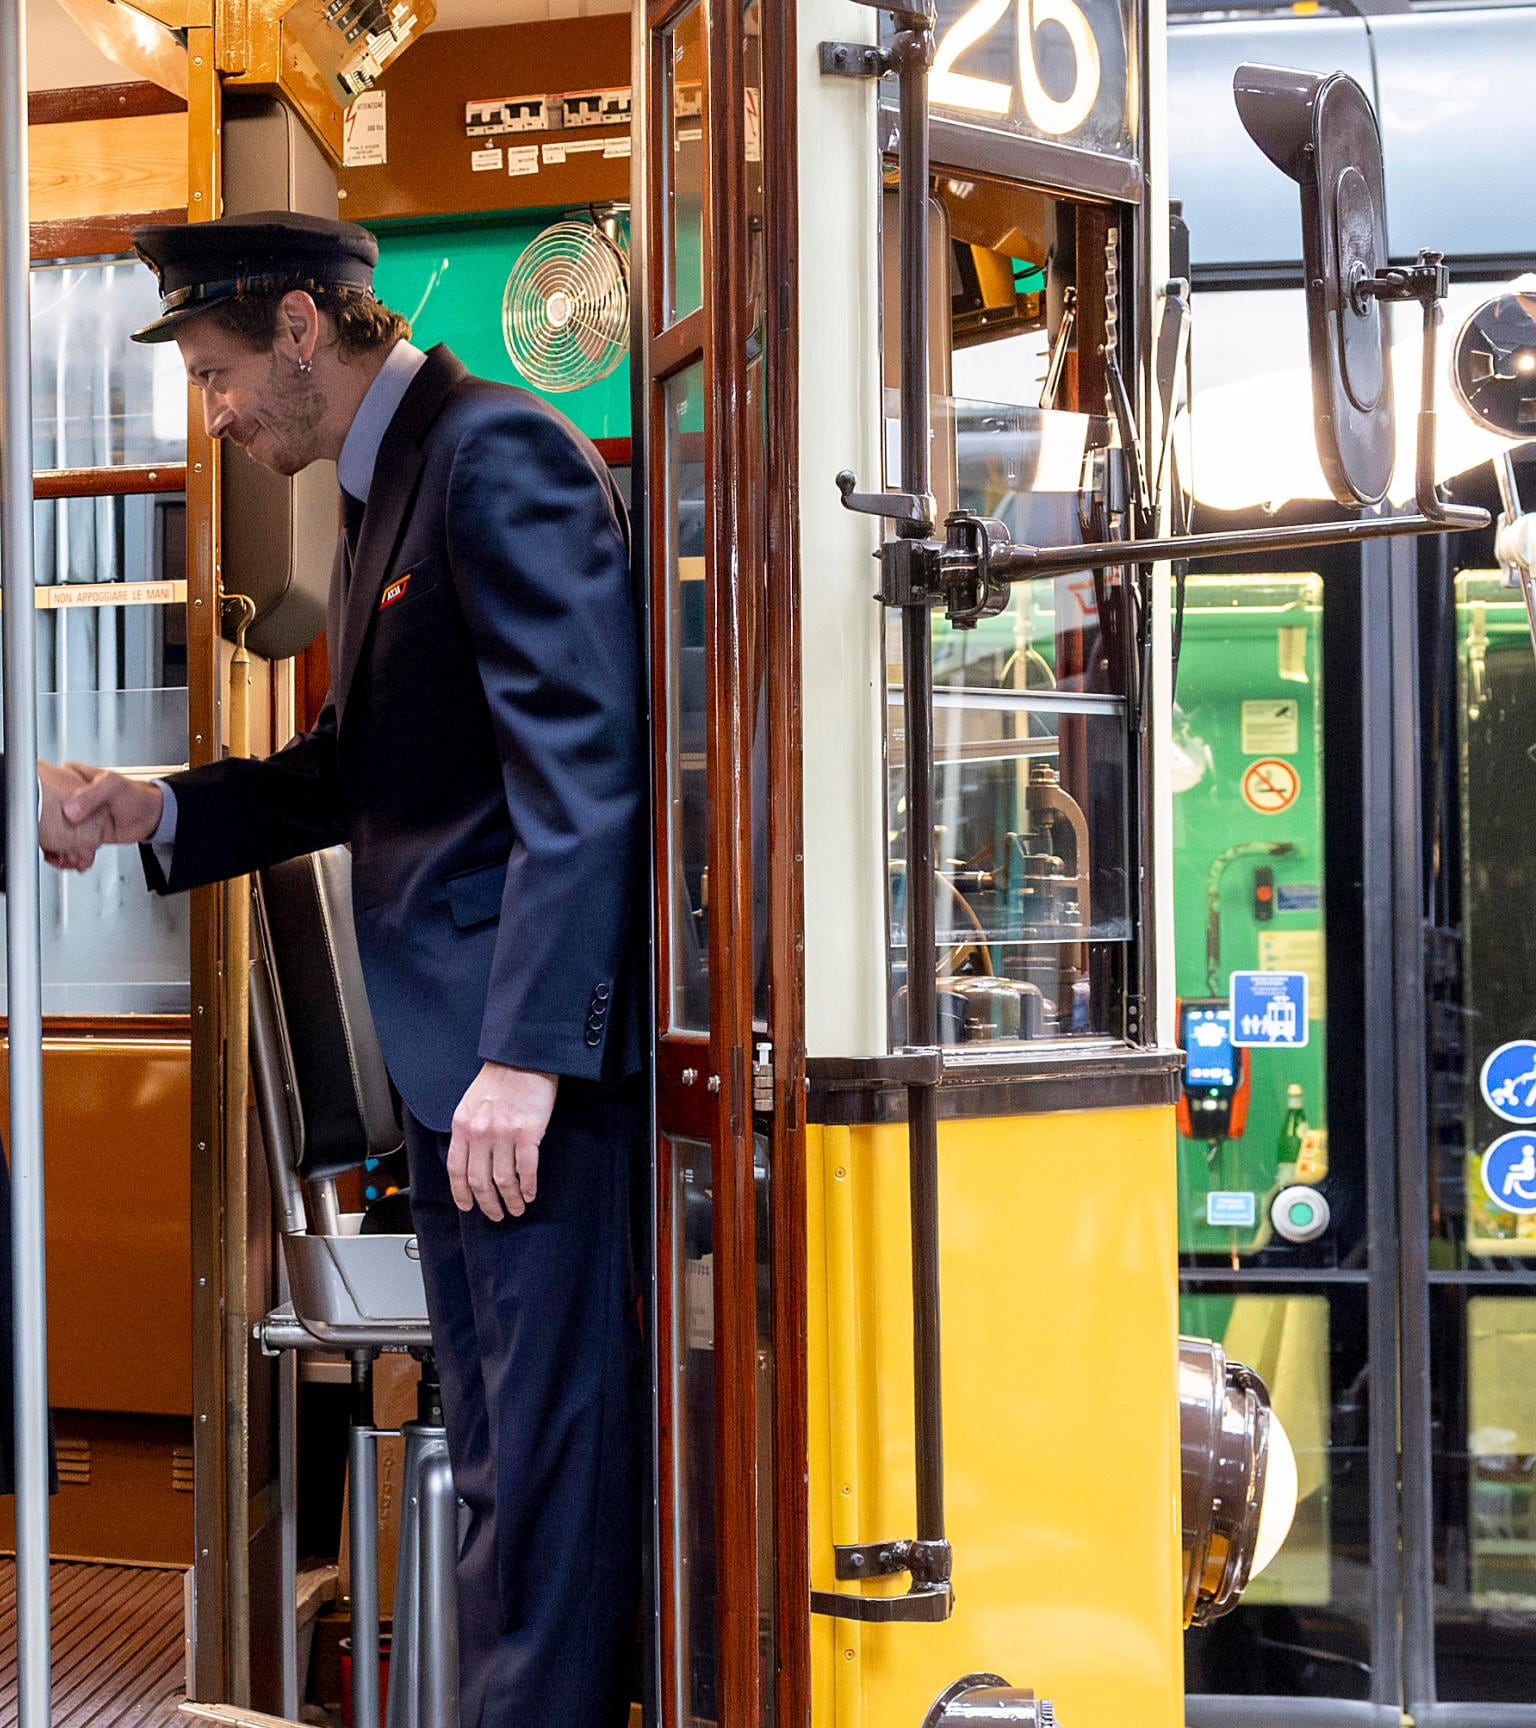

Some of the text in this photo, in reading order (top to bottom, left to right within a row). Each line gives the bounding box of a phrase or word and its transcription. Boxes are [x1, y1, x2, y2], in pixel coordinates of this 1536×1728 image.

[927, 0, 1101, 135] 26
[53, 588, 170, 603] NON APPOGGIARE LE MANI
